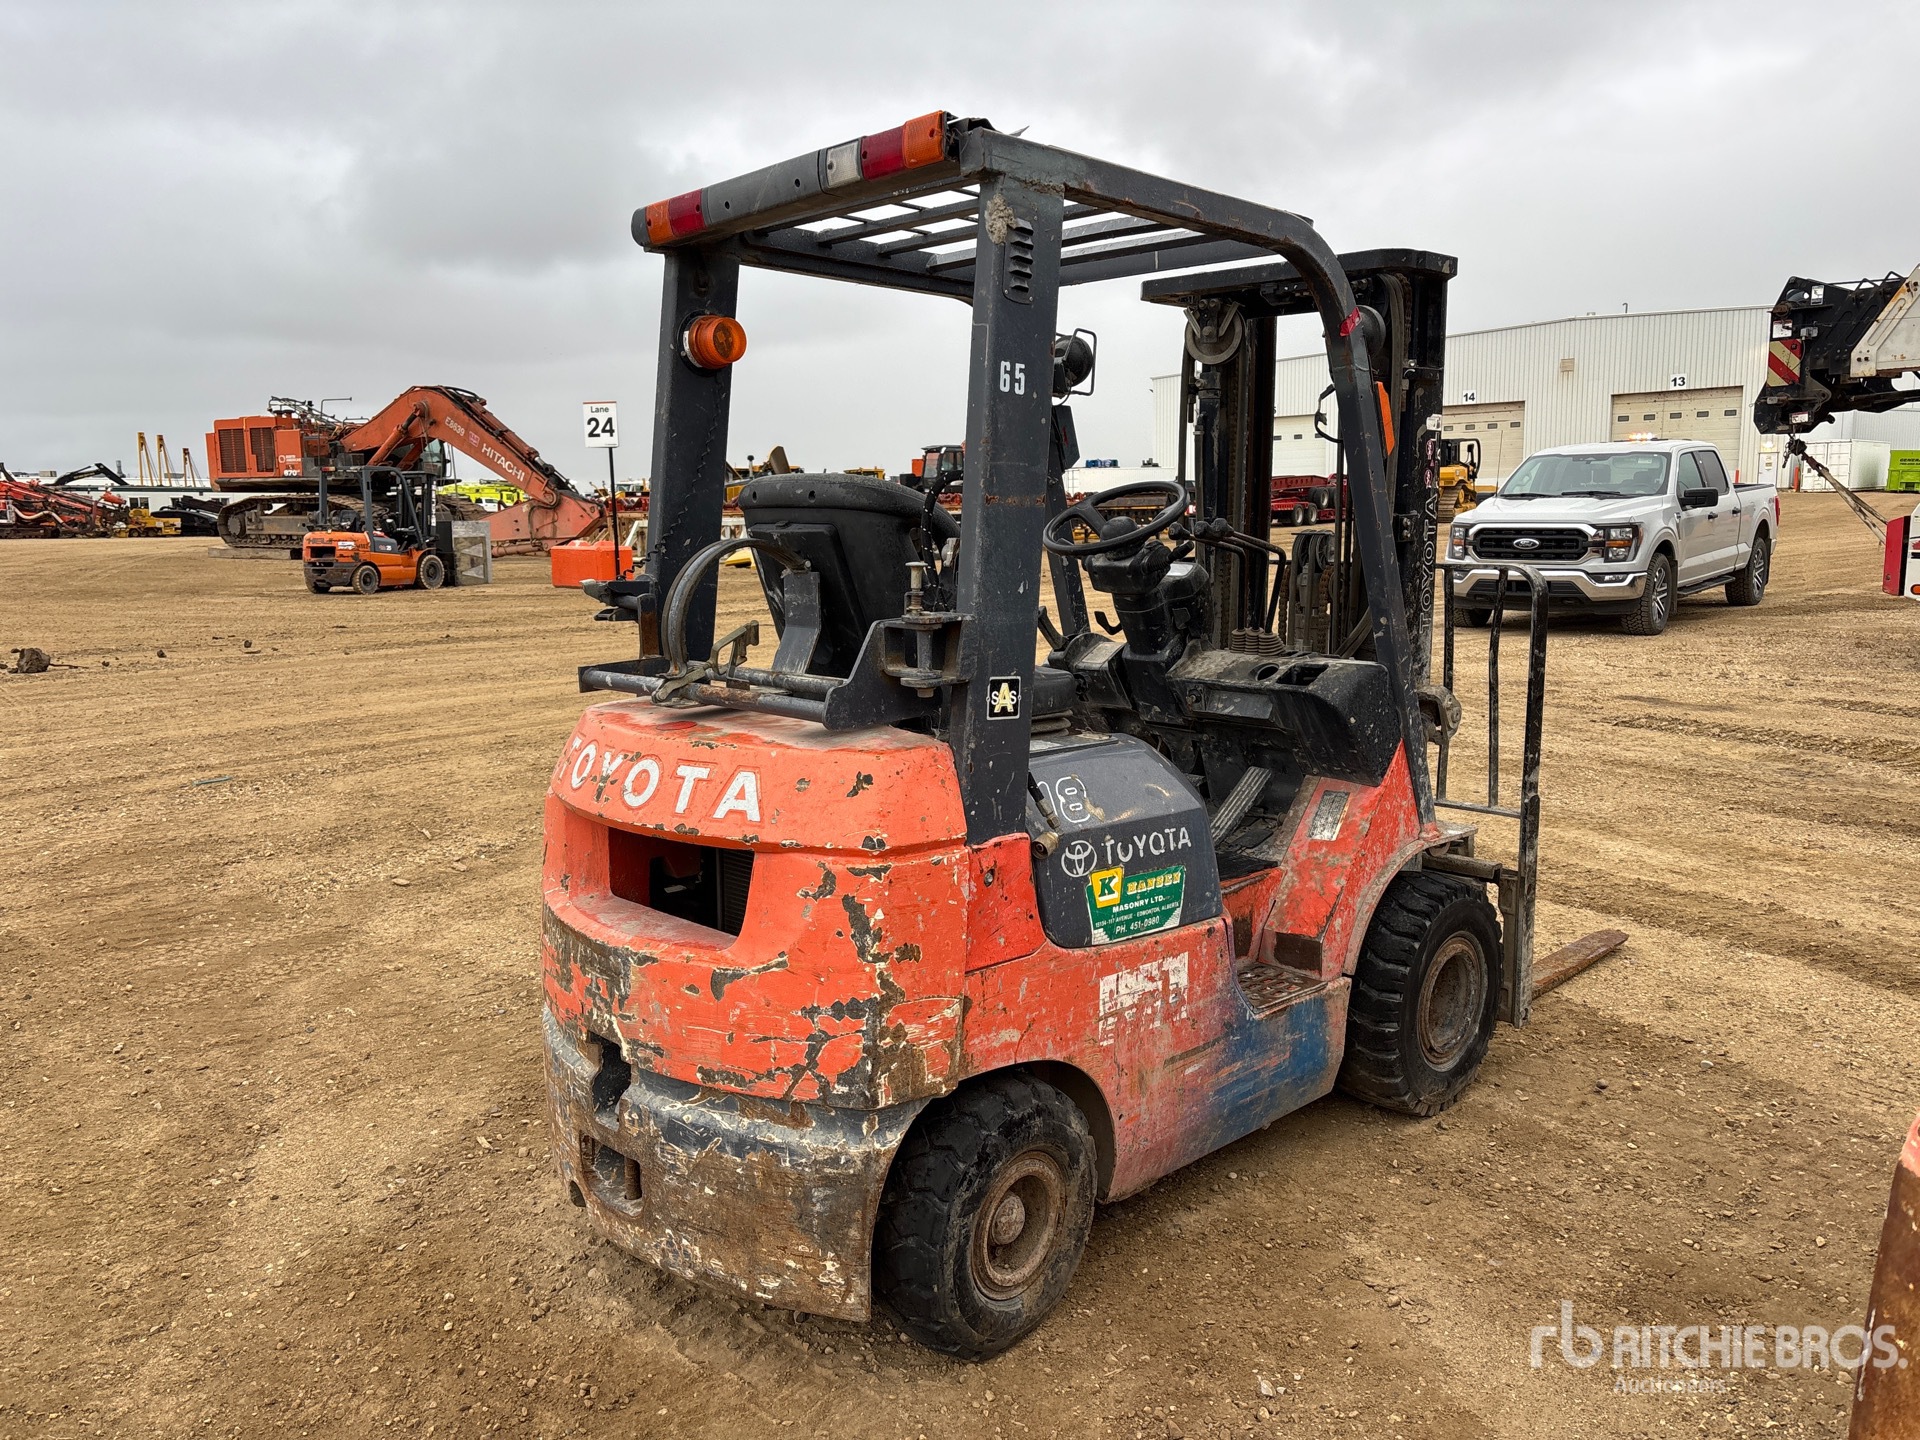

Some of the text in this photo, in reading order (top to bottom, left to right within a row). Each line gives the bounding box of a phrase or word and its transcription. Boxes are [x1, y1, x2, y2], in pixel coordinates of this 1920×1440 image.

[999, 360, 1026, 396] 65
[1671, 376, 1686, 387] 13
[590, 405, 610, 413] Lane
[1463, 392, 1476, 402] 14
[586, 416, 616, 438] 24
[481, 443, 526, 482] HITACHI
[1418, 492, 1438, 634] TOYOTA
[990, 682, 1018, 713] SAS
[557, 735, 762, 823] TOYOTA
[1101, 826, 1192, 865] TOYOTA
[1097, 873, 1119, 902] K
[1112, 894, 1166, 913] MASONRY LTD.
[1161, 901, 1179, 911] ALBERTA
[1115, 915, 1160, 934] PH. 451-0980
